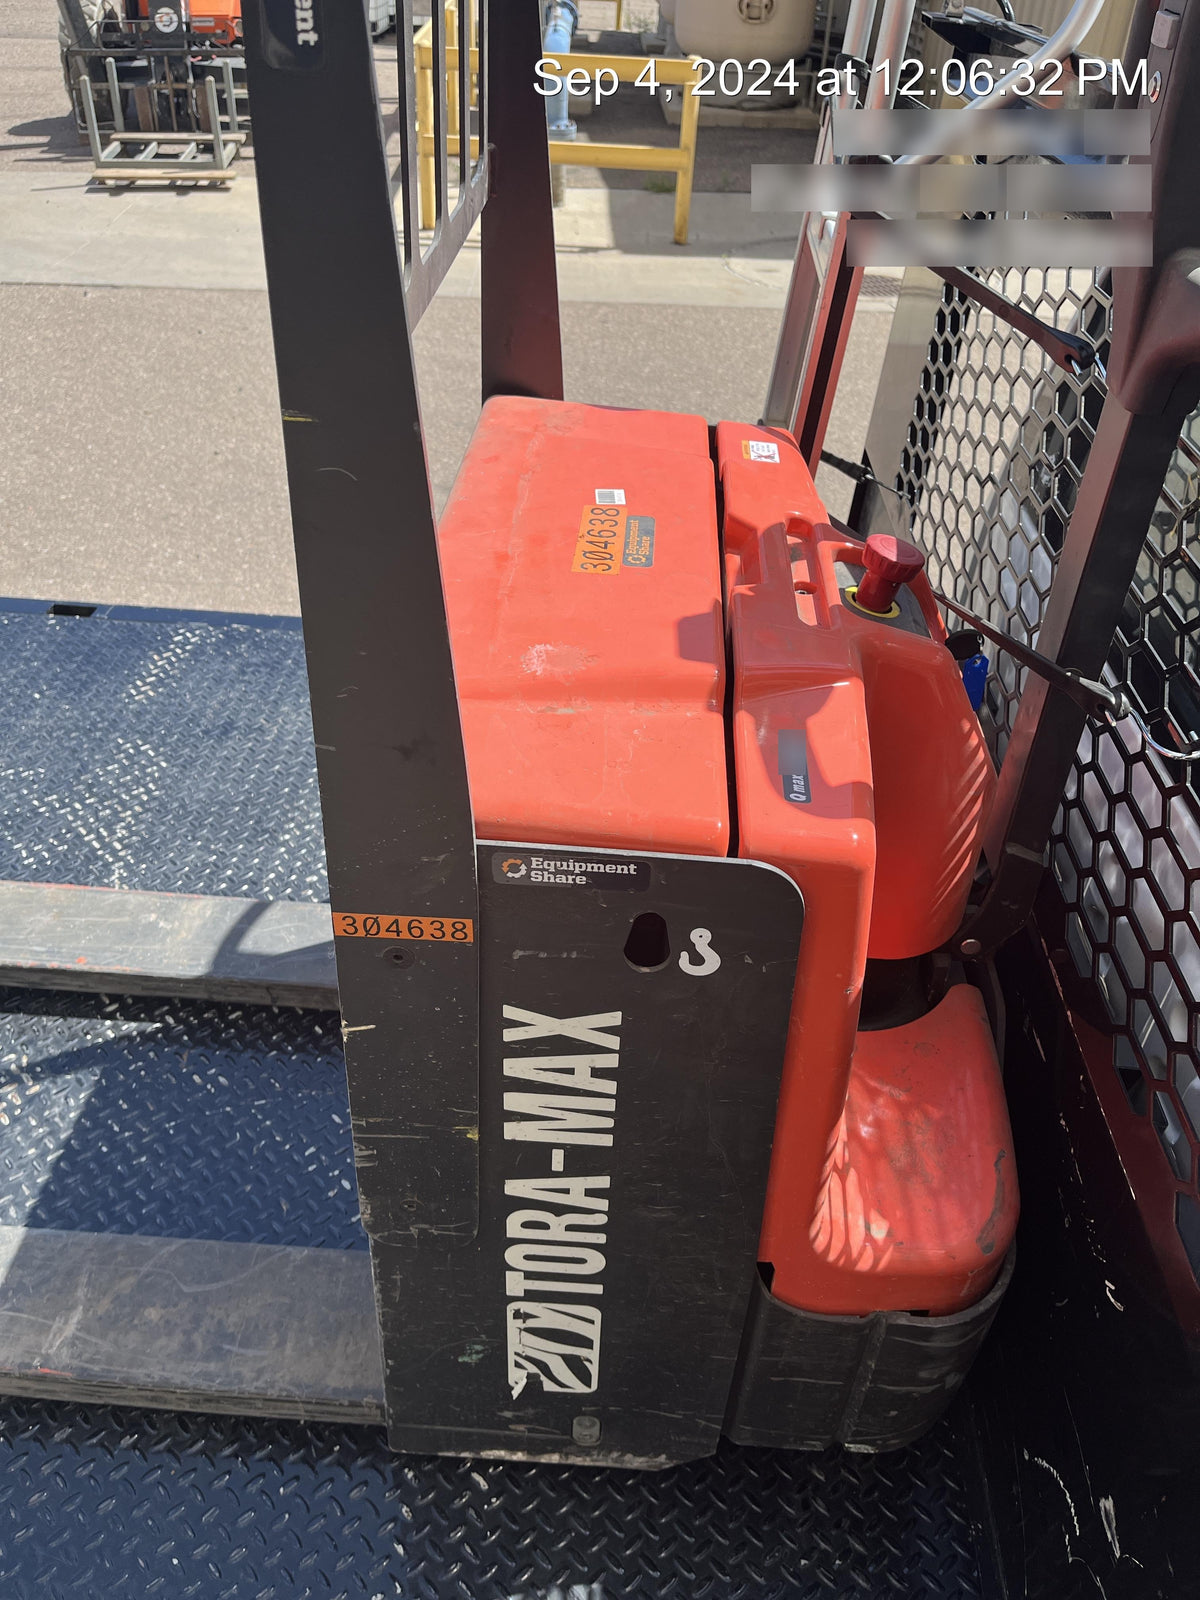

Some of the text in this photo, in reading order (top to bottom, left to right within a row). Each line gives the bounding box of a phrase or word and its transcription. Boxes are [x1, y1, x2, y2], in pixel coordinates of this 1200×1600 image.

[626, 519, 640, 554] Equipment
[638, 535, 650, 556] Share
[792, 775, 806, 793] max
[789, 793, 807, 801] Q
[530, 856, 638, 876] Equipment
[530, 870, 587, 885] Share
[502, 1004, 623, 1298] TORA-MAX
